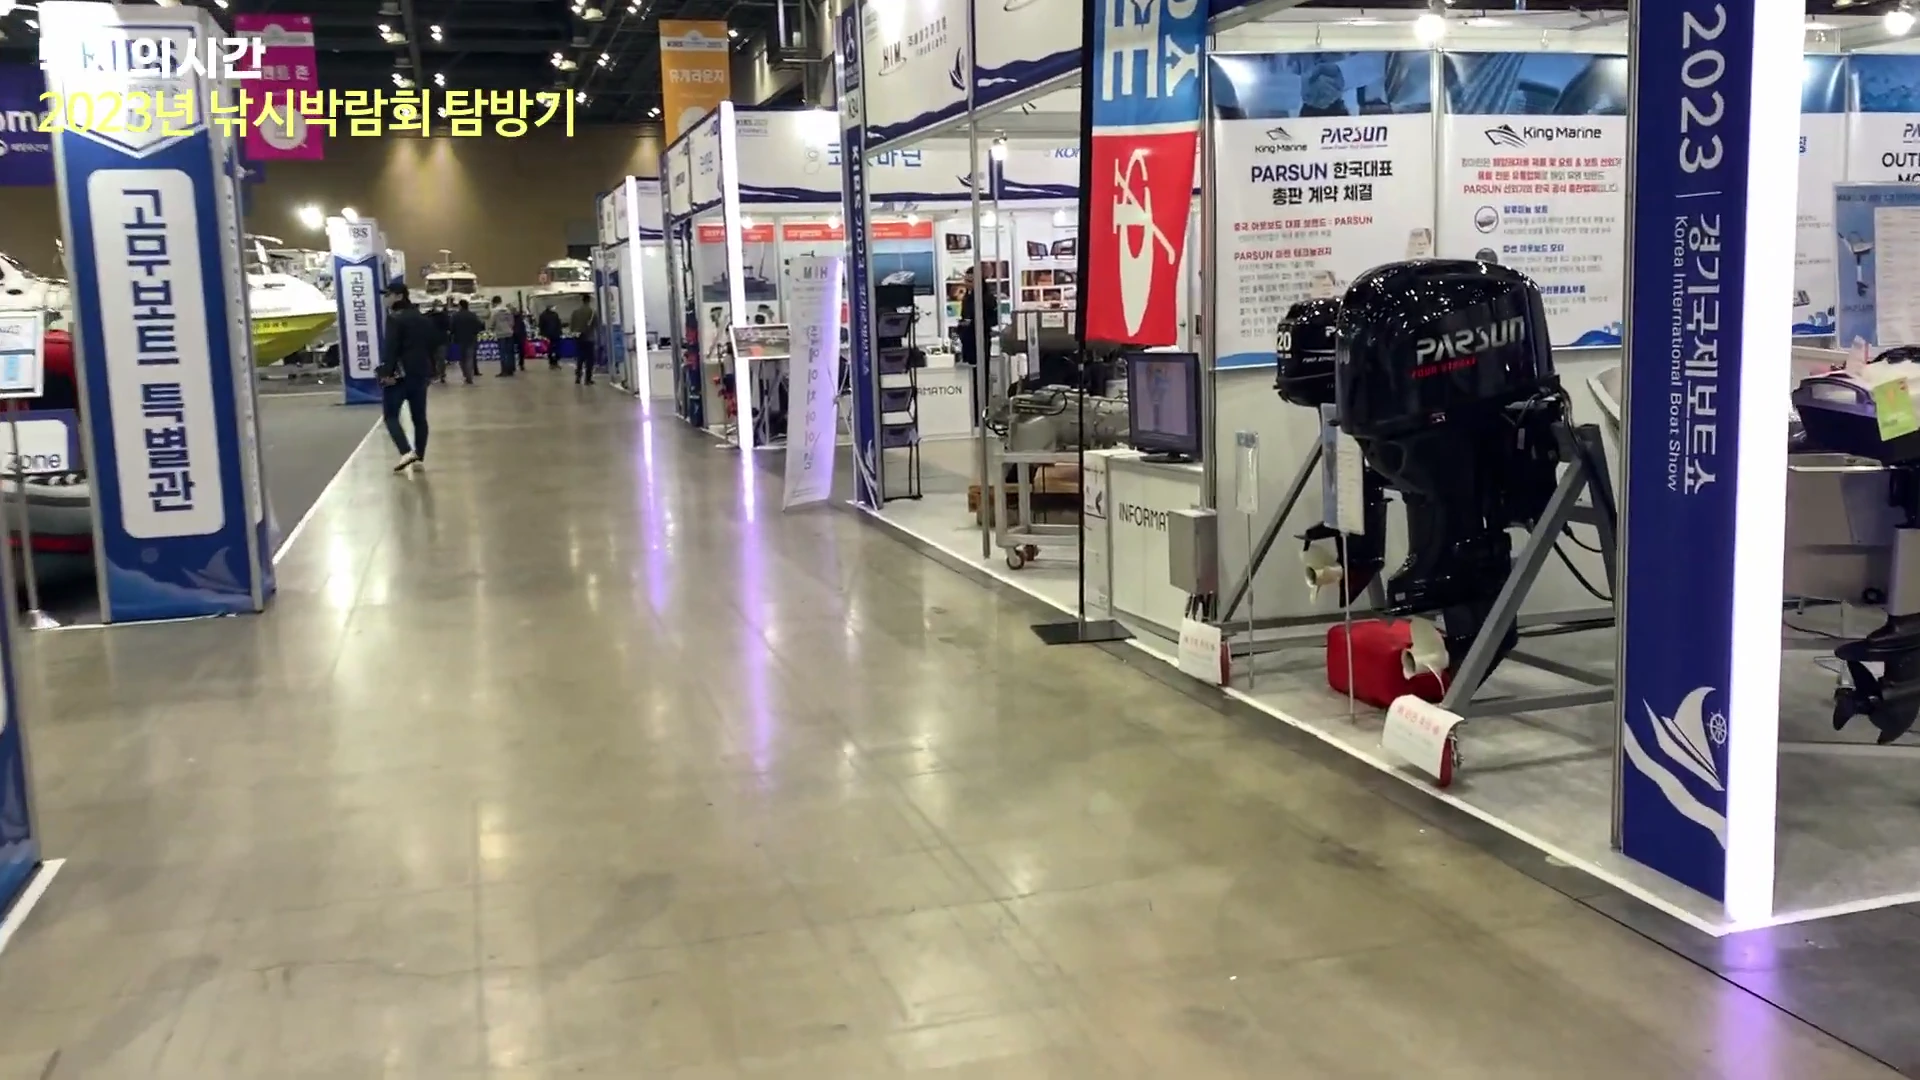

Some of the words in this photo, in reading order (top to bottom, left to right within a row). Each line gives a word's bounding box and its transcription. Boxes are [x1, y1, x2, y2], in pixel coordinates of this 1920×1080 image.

[1680, 3, 1727, 173] 2023
[1255, 145, 1275, 154] King
[1276, 144, 1308, 153] Marine
[1321, 126, 1388, 144] PARSUN
[1523, 126, 1554, 141] King
[1556, 126, 1602, 139] Marine
[1251, 163, 1328, 183] PARSUN
[1333, 160, 1393, 179] 한국대표
[1463, 183, 1501, 194] PARSUN
[1272, 187, 1303, 206] 총판
[1308, 185, 1339, 204] 계약
[1343, 184, 1373, 202] 체결
[1335, 216, 1374, 227] PARSUN
[1673, 215, 1689, 267] Korea
[121, 188, 180, 366] 고무보트
[1234, 250, 1273, 262] PARSUN
[1416, 315, 1525, 366] PARSUN
[1671, 273, 1687, 386] International
[1684, 212, 1721, 494] 경기국제보트쇼
[1669, 392, 1683, 434] Boat
[141, 382, 196, 513] 특별관
[1667, 440, 1682, 491] Show
